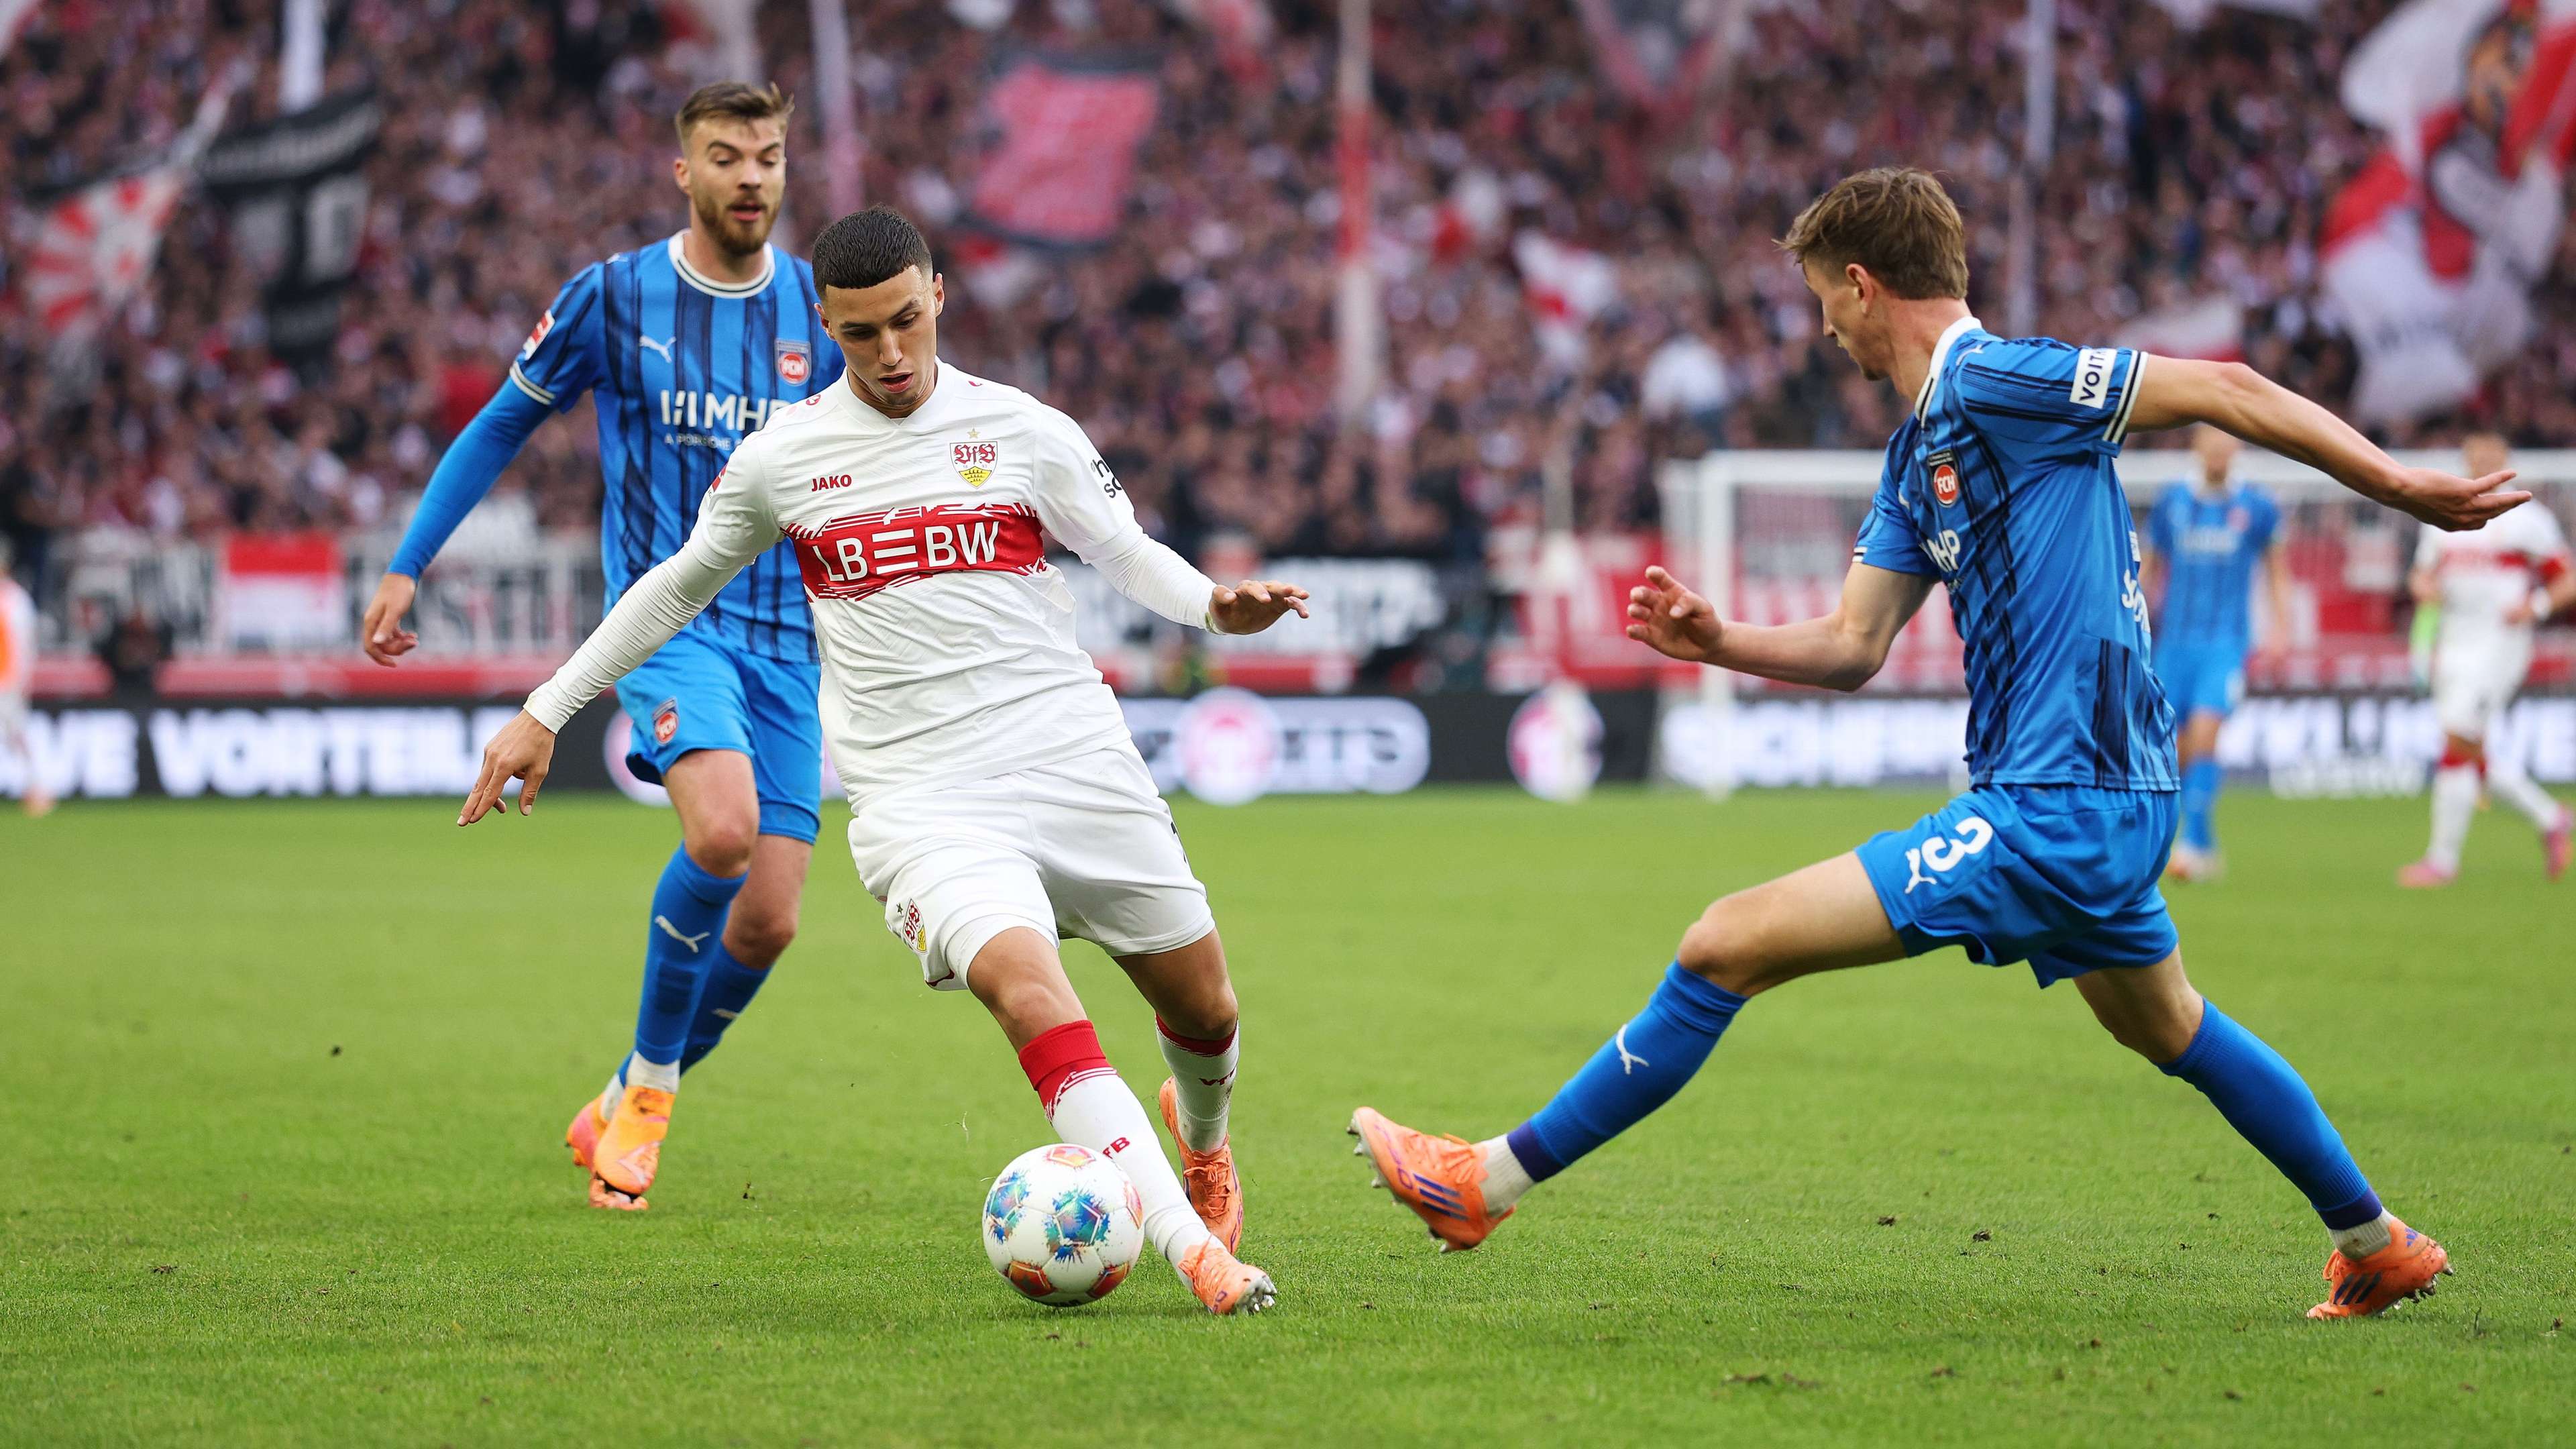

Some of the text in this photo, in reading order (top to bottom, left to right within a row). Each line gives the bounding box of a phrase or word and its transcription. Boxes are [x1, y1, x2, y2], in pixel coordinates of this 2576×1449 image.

[2078, 351, 2104, 401] VOIT
[811, 474, 853, 492] JAKO
[1936, 476, 1956, 495] FCH
[1921, 816, 1994, 872] 3
[1102, 1137, 1130, 1159] FB
